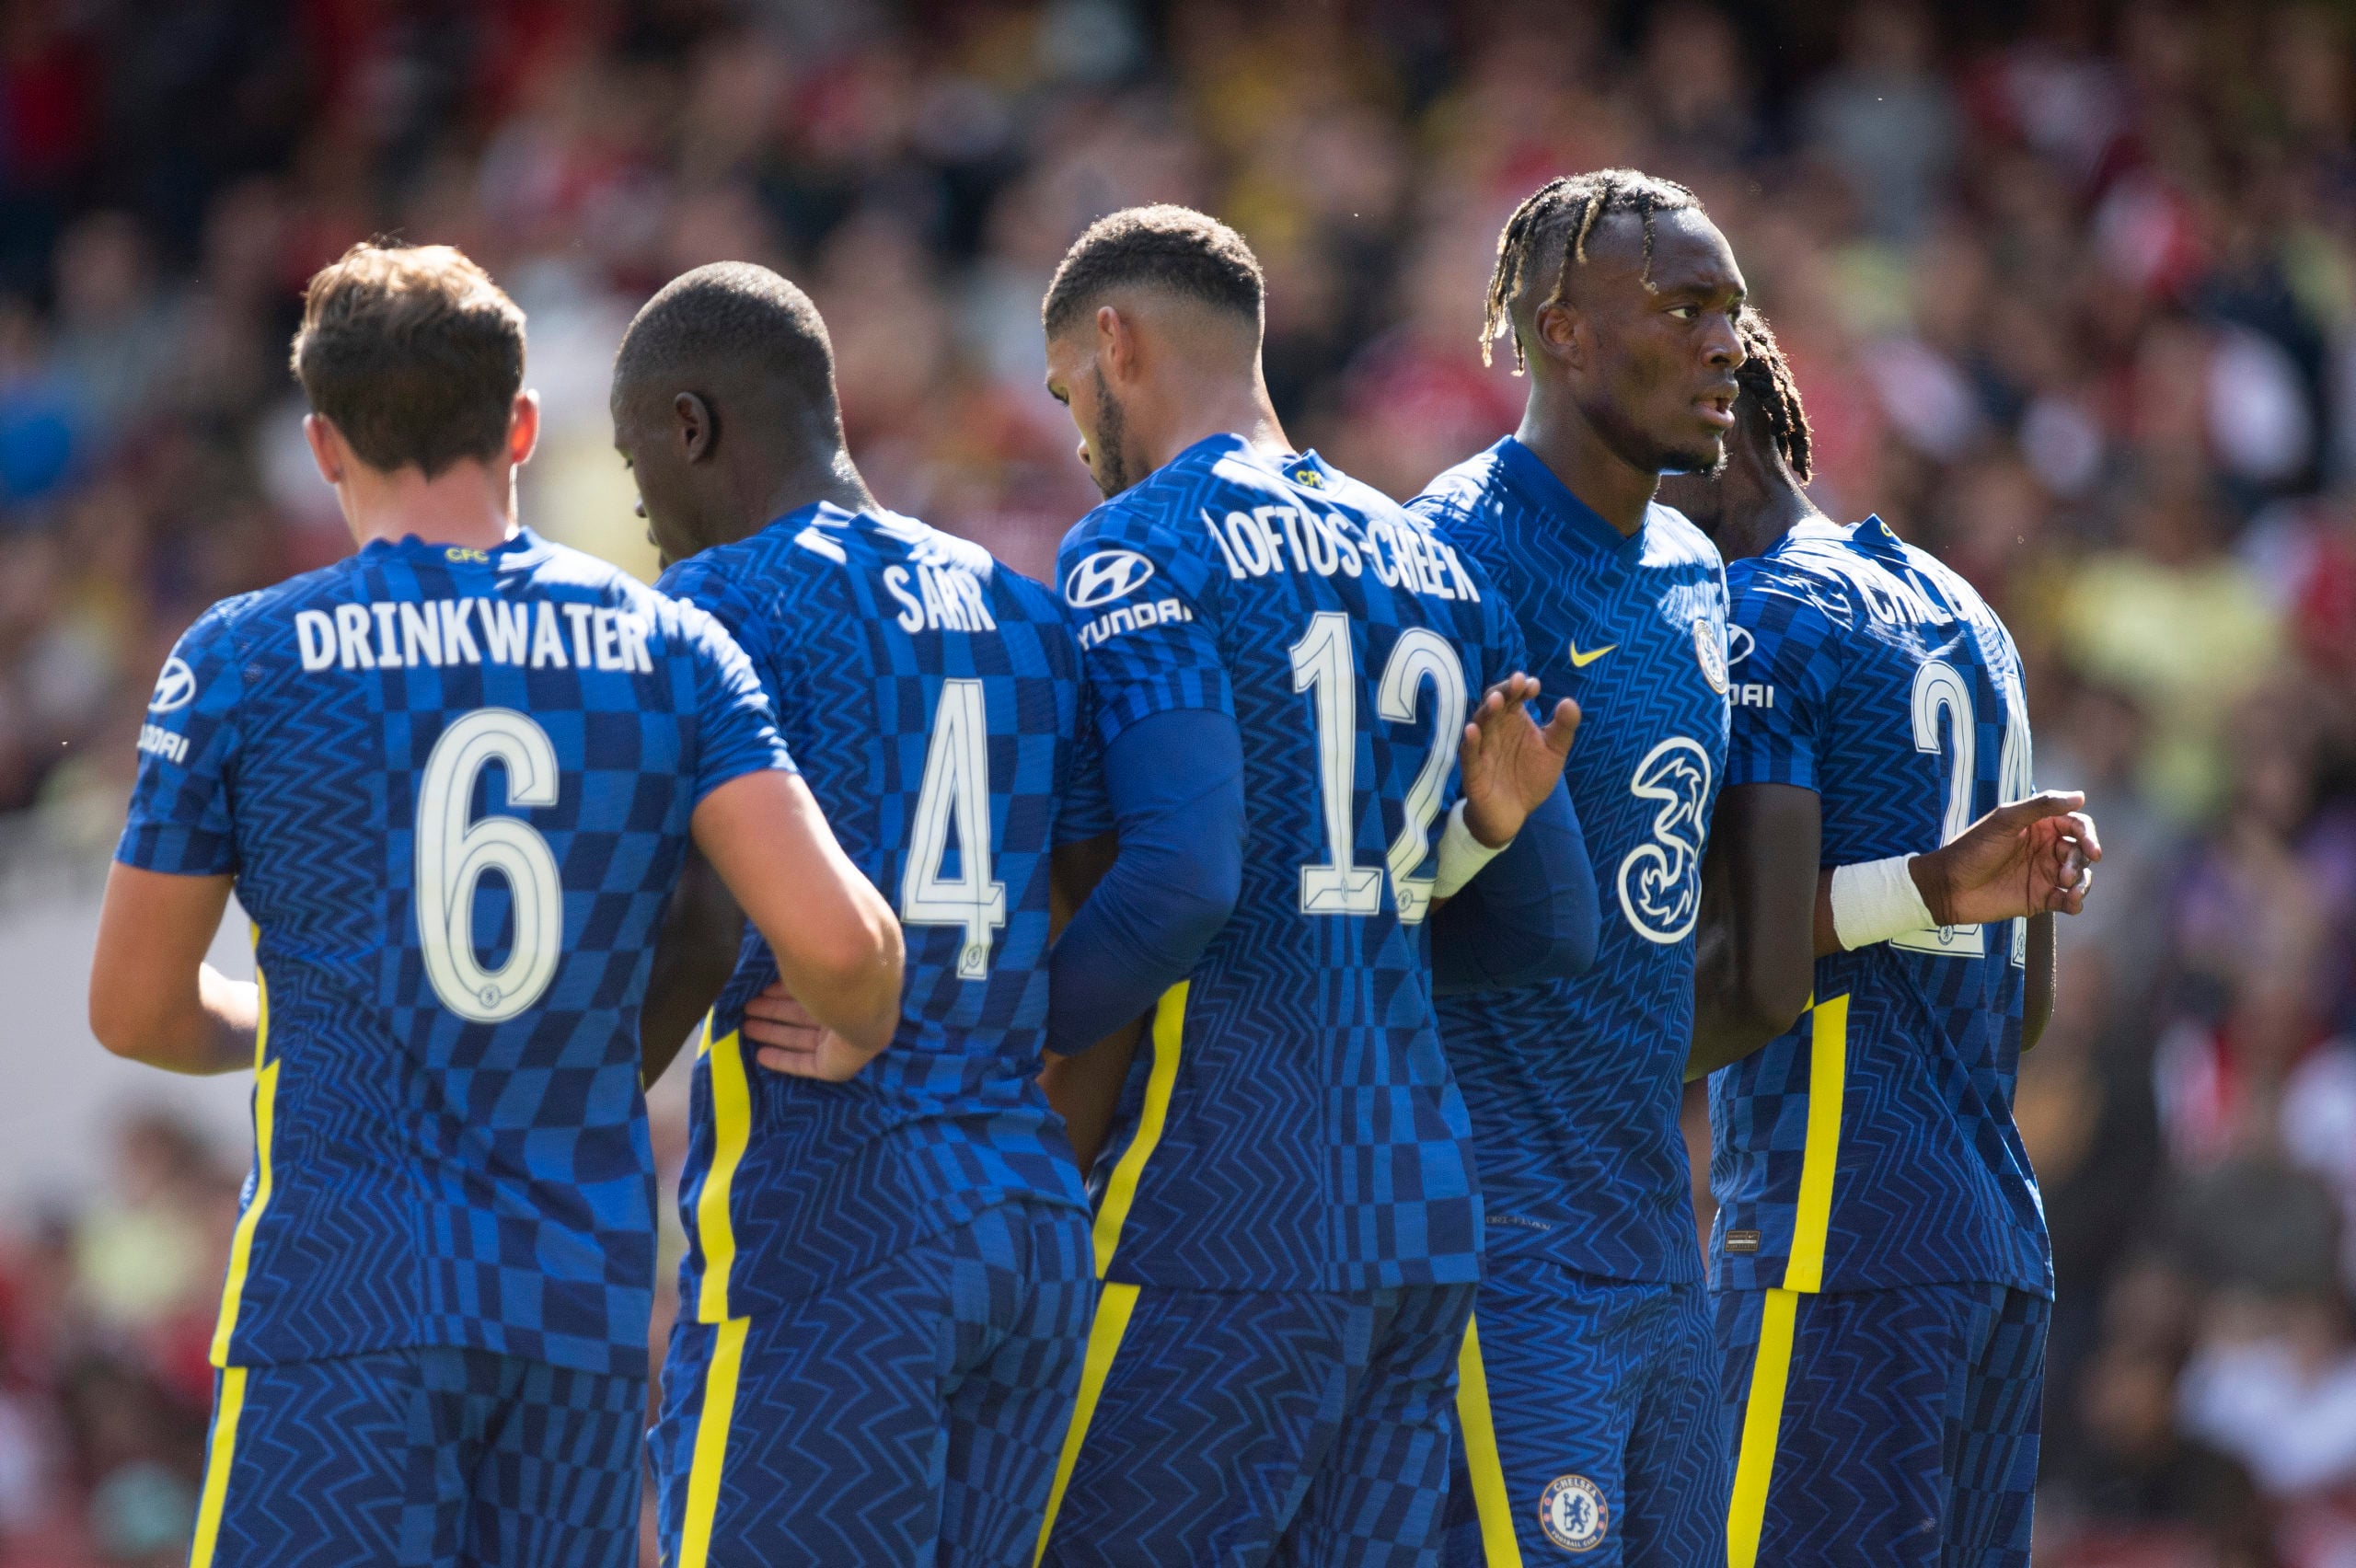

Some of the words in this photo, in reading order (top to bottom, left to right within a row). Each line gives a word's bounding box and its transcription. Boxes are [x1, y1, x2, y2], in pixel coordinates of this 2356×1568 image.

[445, 548, 490, 563] CFC
[294, 597, 653, 674] DRINKWATER
[883, 564, 997, 634] SARR
[1078, 598, 1193, 651] YUNDAI
[1288, 611, 1468, 926] 12
[414, 708, 564, 1023] 6
[900, 678, 1005, 980] 4
[1553, 1478, 1597, 1497] CHELSEA
